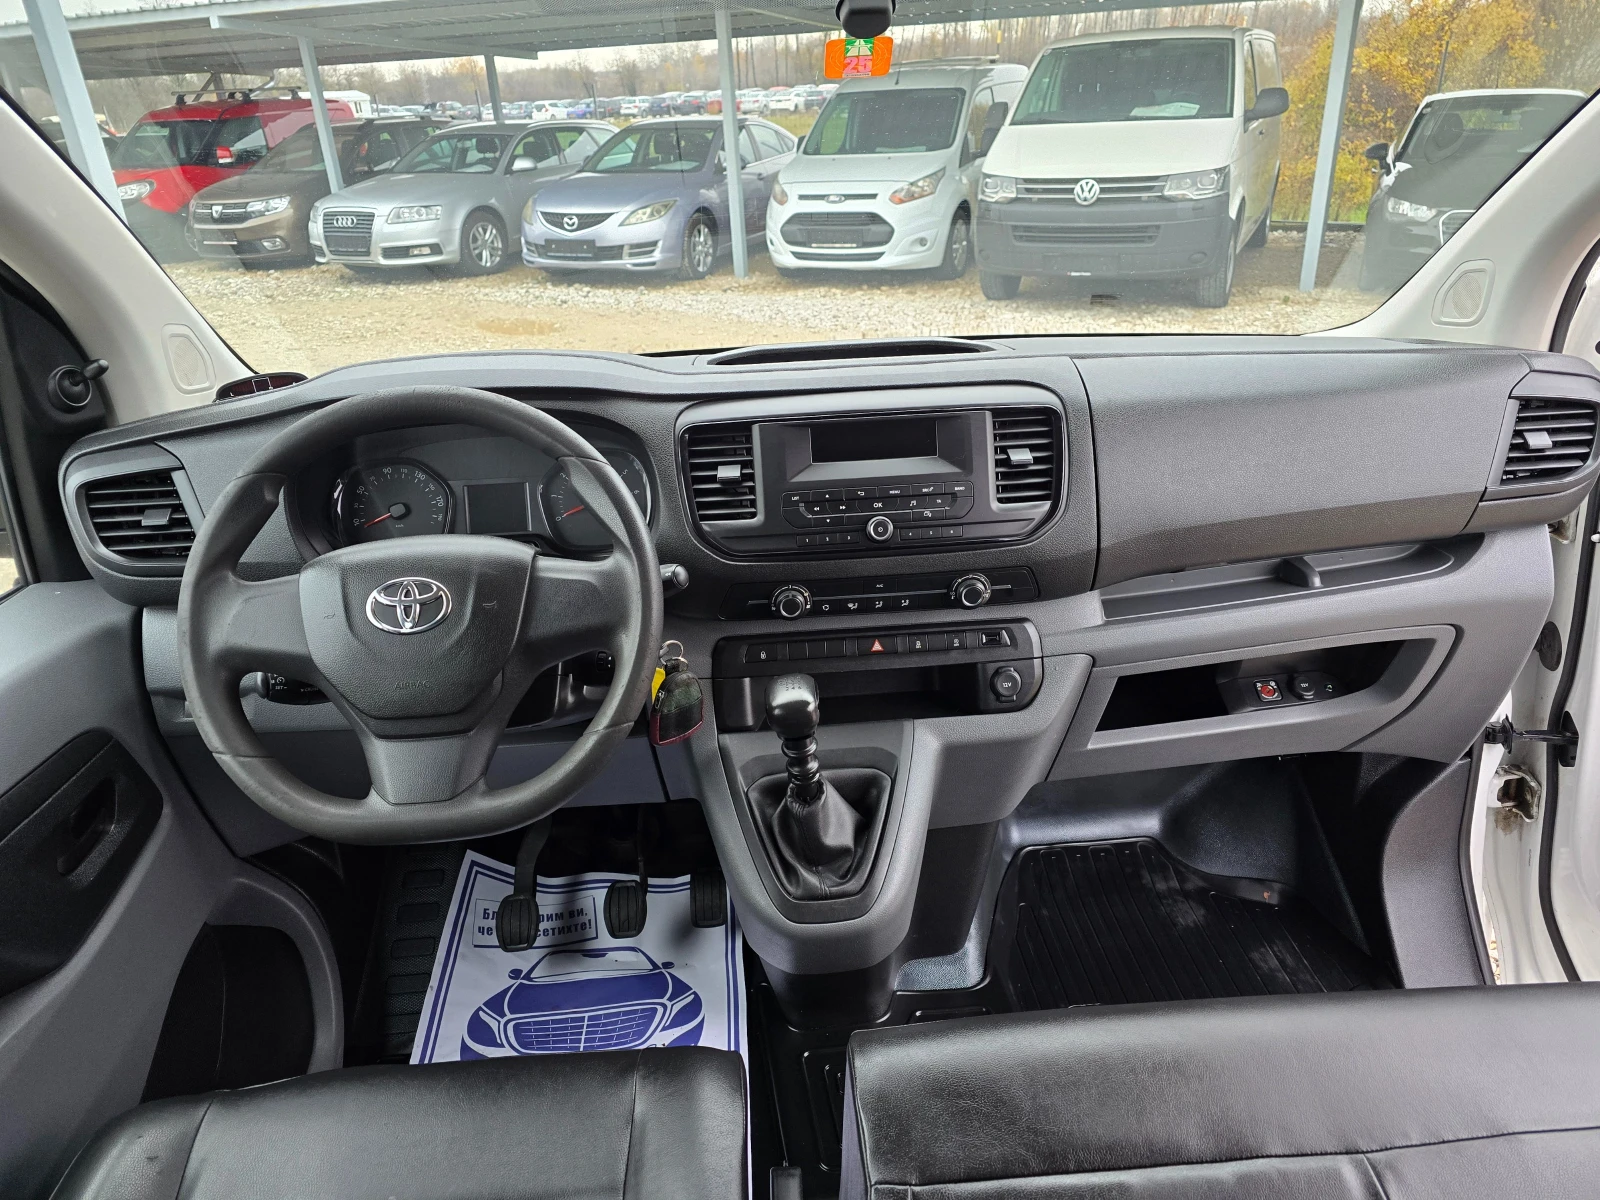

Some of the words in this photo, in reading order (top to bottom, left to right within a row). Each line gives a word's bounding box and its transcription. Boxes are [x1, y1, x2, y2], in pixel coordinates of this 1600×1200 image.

[843, 55, 872, 74] 25
[414, 470, 426, 481] 130
[357, 486, 365, 495] 50
[428, 482, 436, 491] 150
[436, 496, 444, 507] 170
[478, 926, 493, 936] че
